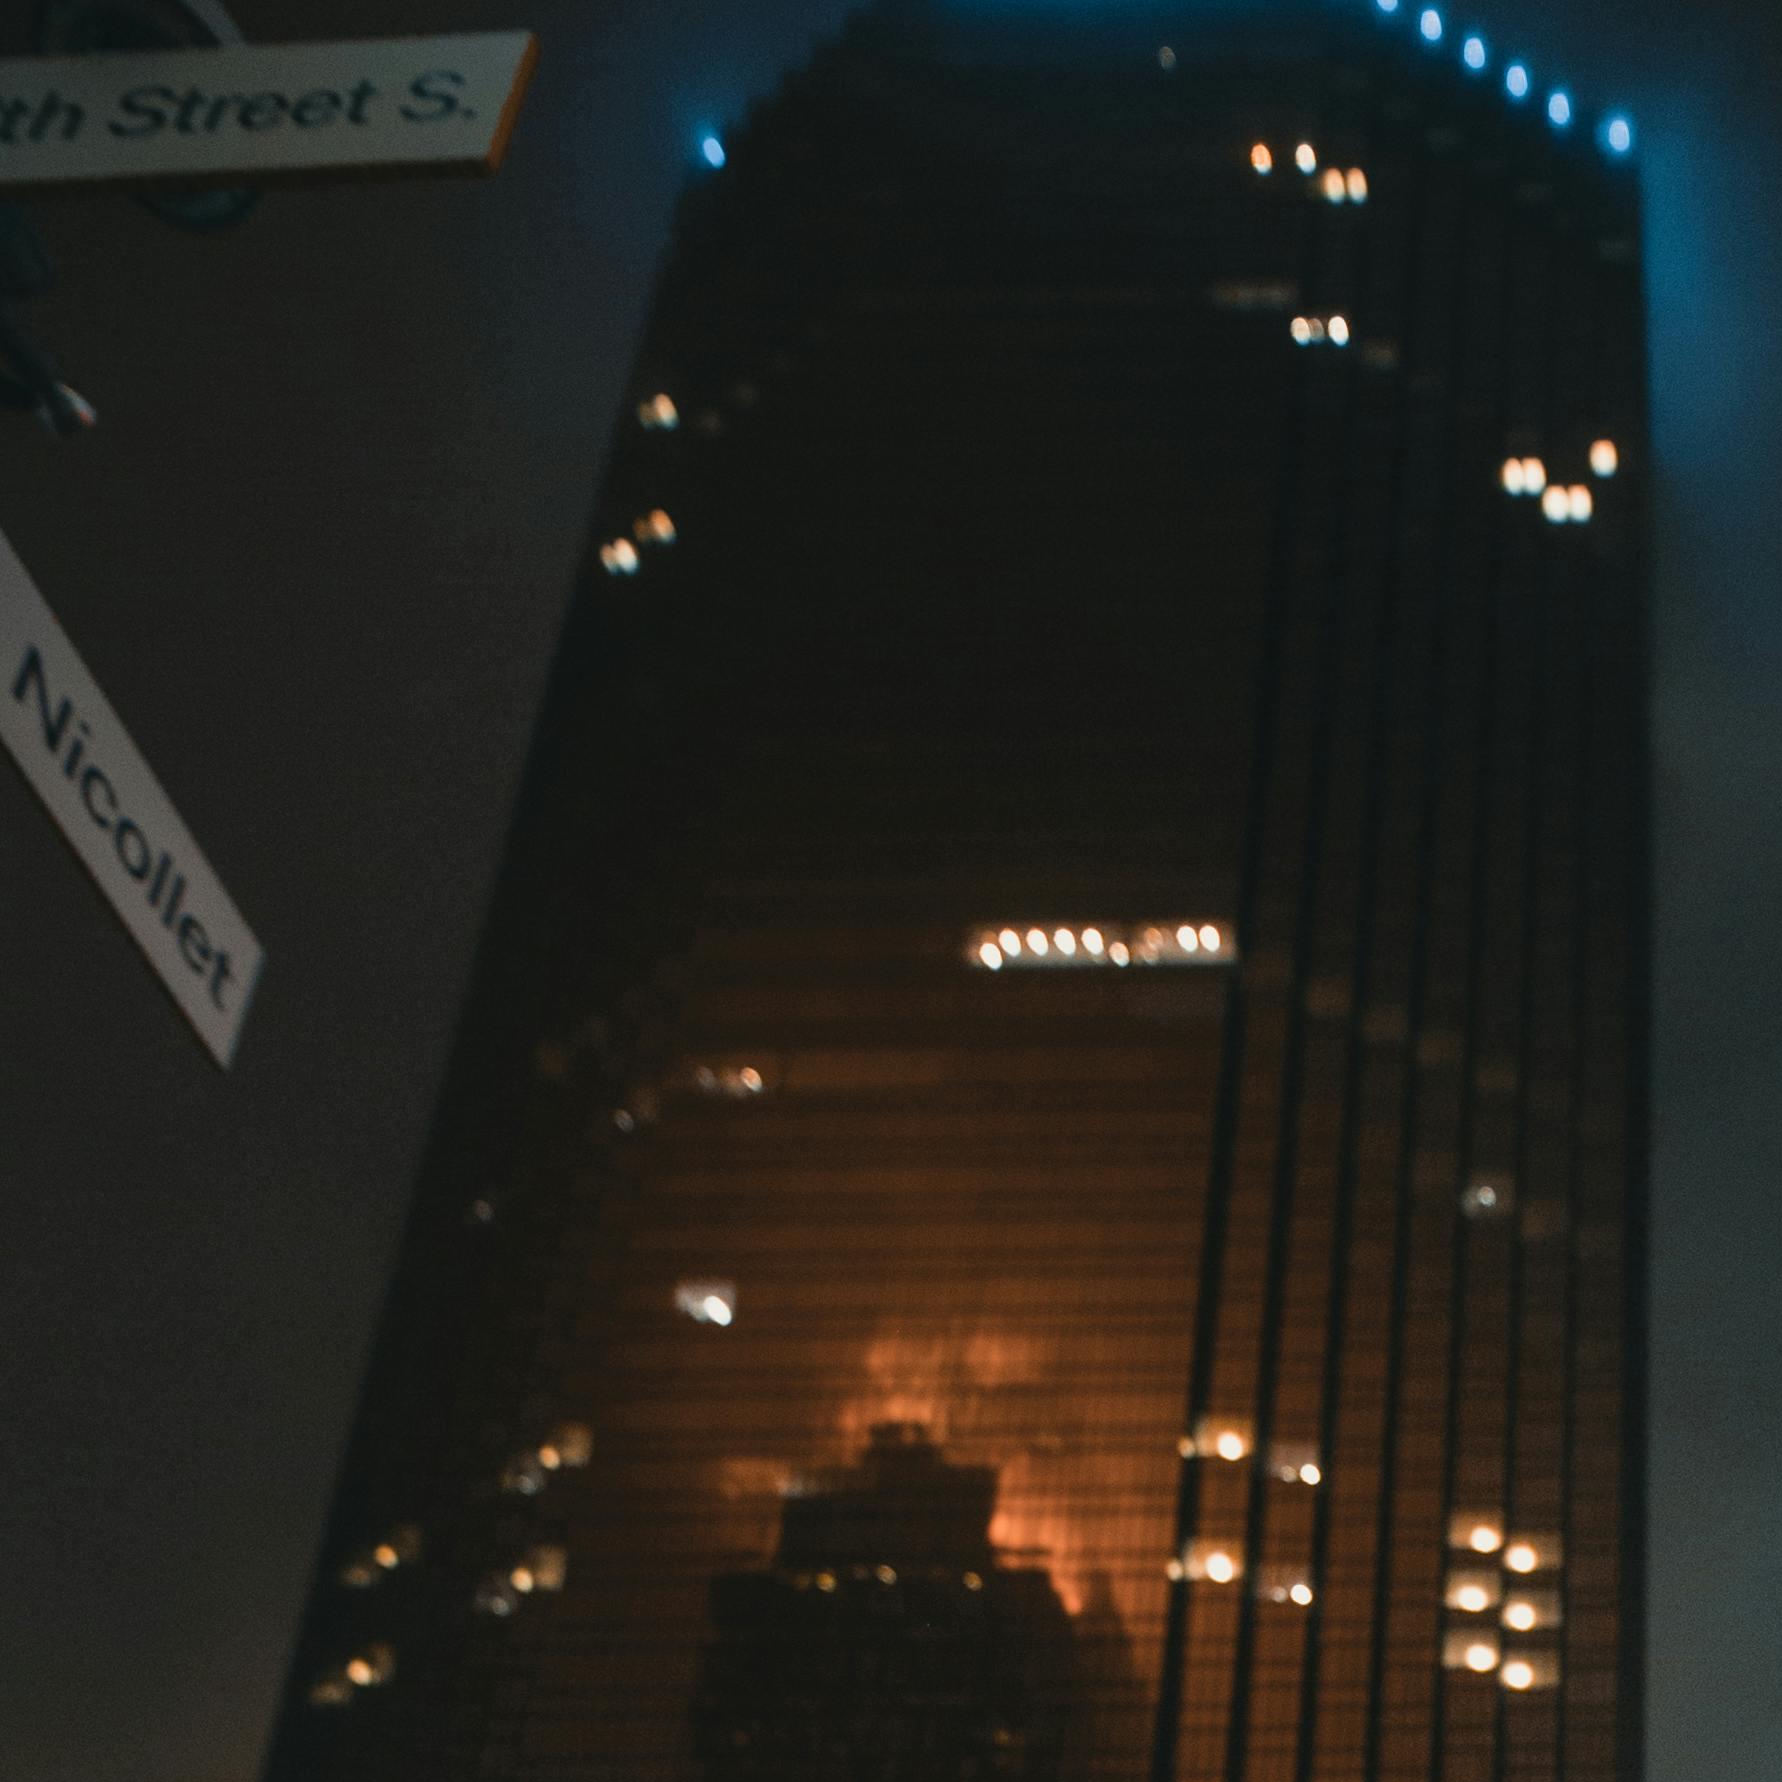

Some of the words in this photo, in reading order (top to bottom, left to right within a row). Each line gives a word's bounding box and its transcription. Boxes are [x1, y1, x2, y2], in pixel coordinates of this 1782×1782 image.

[108, 78, 376, 138] Street
[401, 70, 478, 122] S.
[13, 643, 234, 1010] Nicollet
